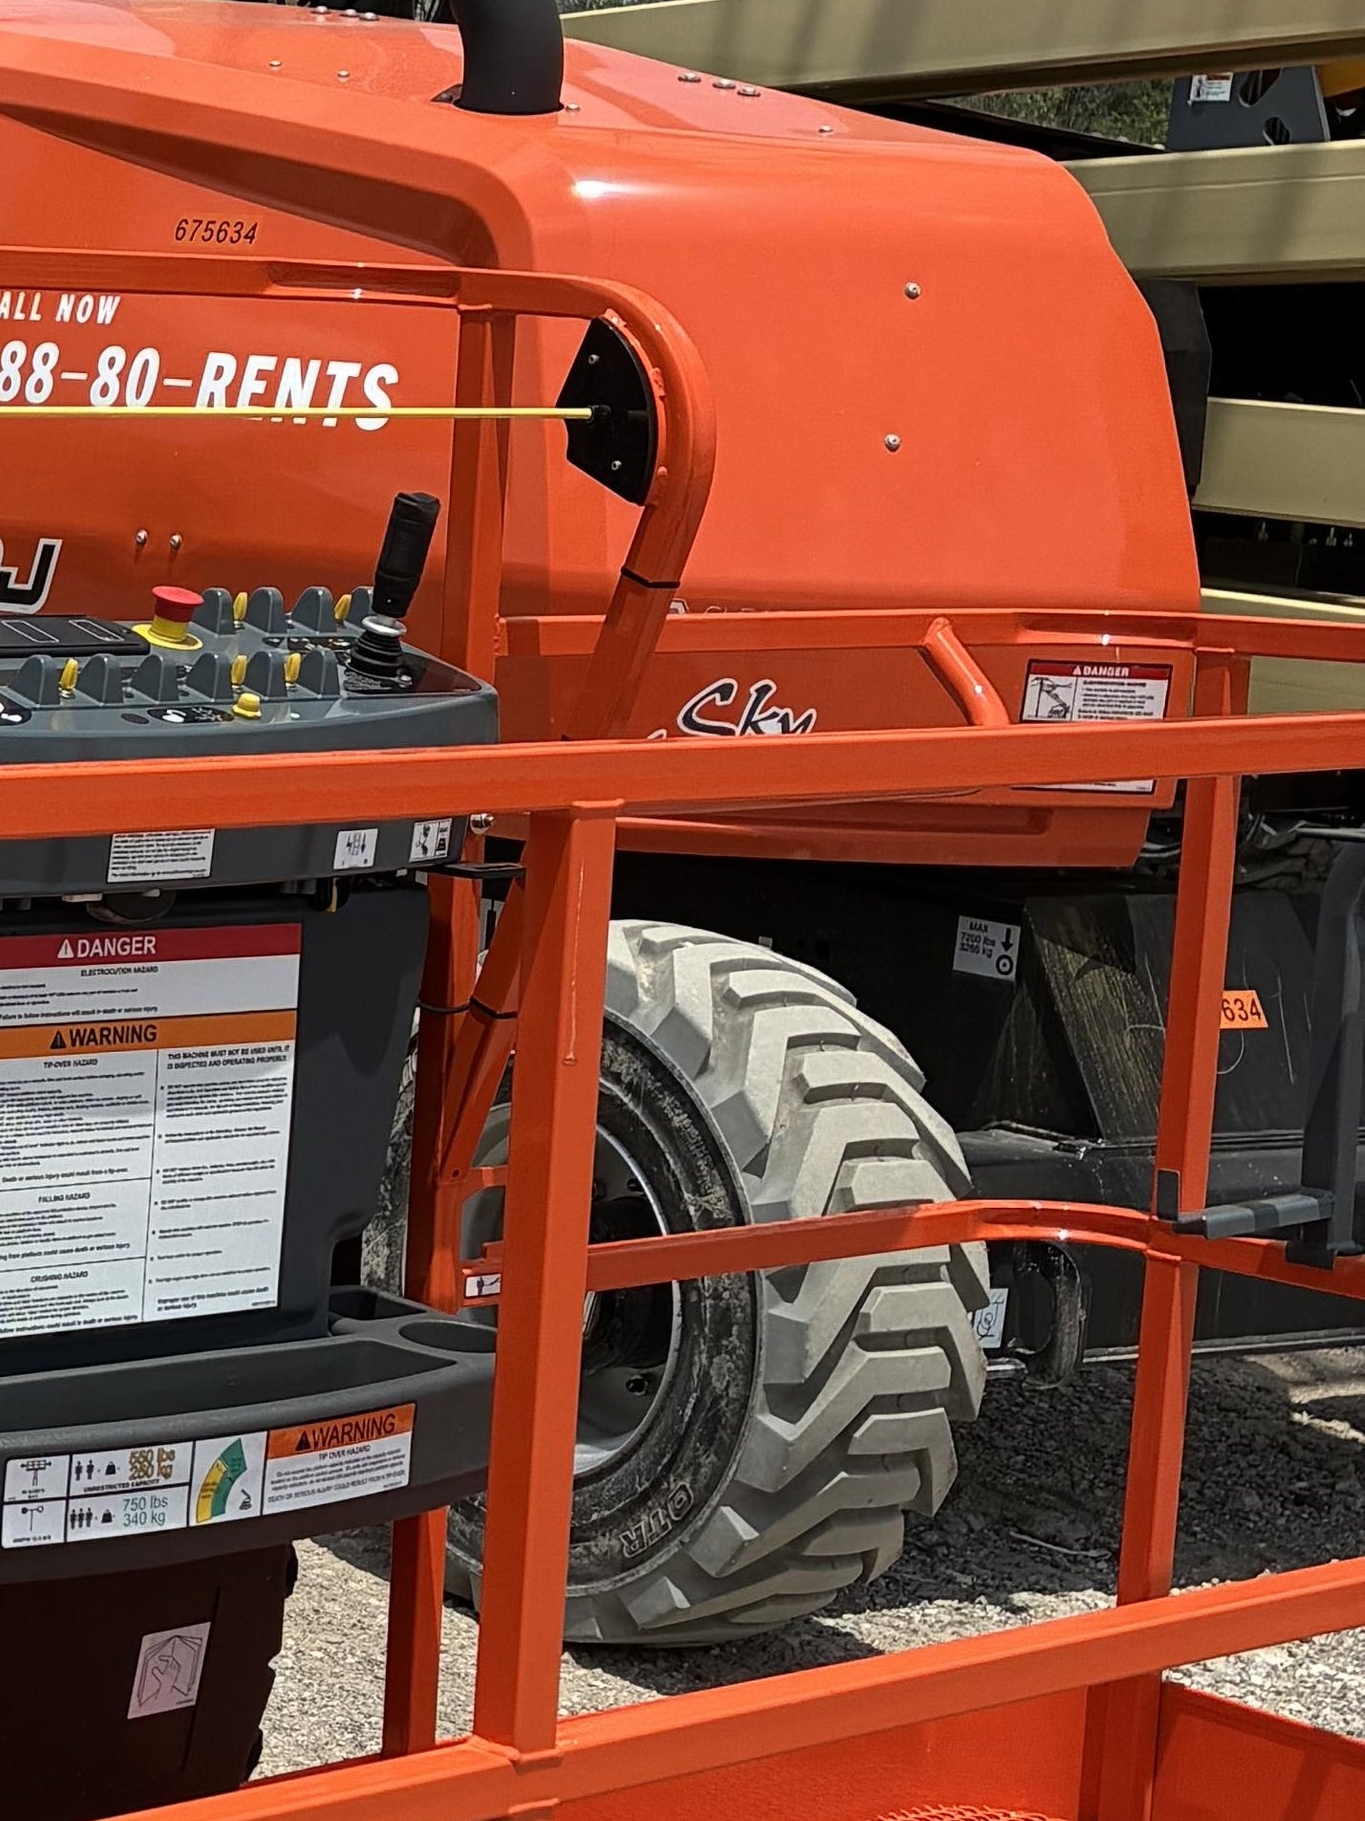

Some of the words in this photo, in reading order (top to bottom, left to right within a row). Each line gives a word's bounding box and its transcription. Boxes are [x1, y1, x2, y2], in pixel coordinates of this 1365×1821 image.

[174, 219, 258, 244] 675634
[56, 294, 121, 325] NOW
[1083, 666, 1129, 677] DANGER
[970, 922, 988, 933] MAX
[77, 936, 157, 959] DANGER
[1221, 998, 1261, 1021] 634
[69, 1024, 157, 1047] WARNING
[312, 1414, 396, 1449] WARNING
[157, 1447, 176, 1463] lbs
[123, 1496, 147, 1512] 750
[150, 1495, 168, 1509] lbs
[123, 1511, 147, 1527] 340
[151, 1510, 166, 1526] kg
